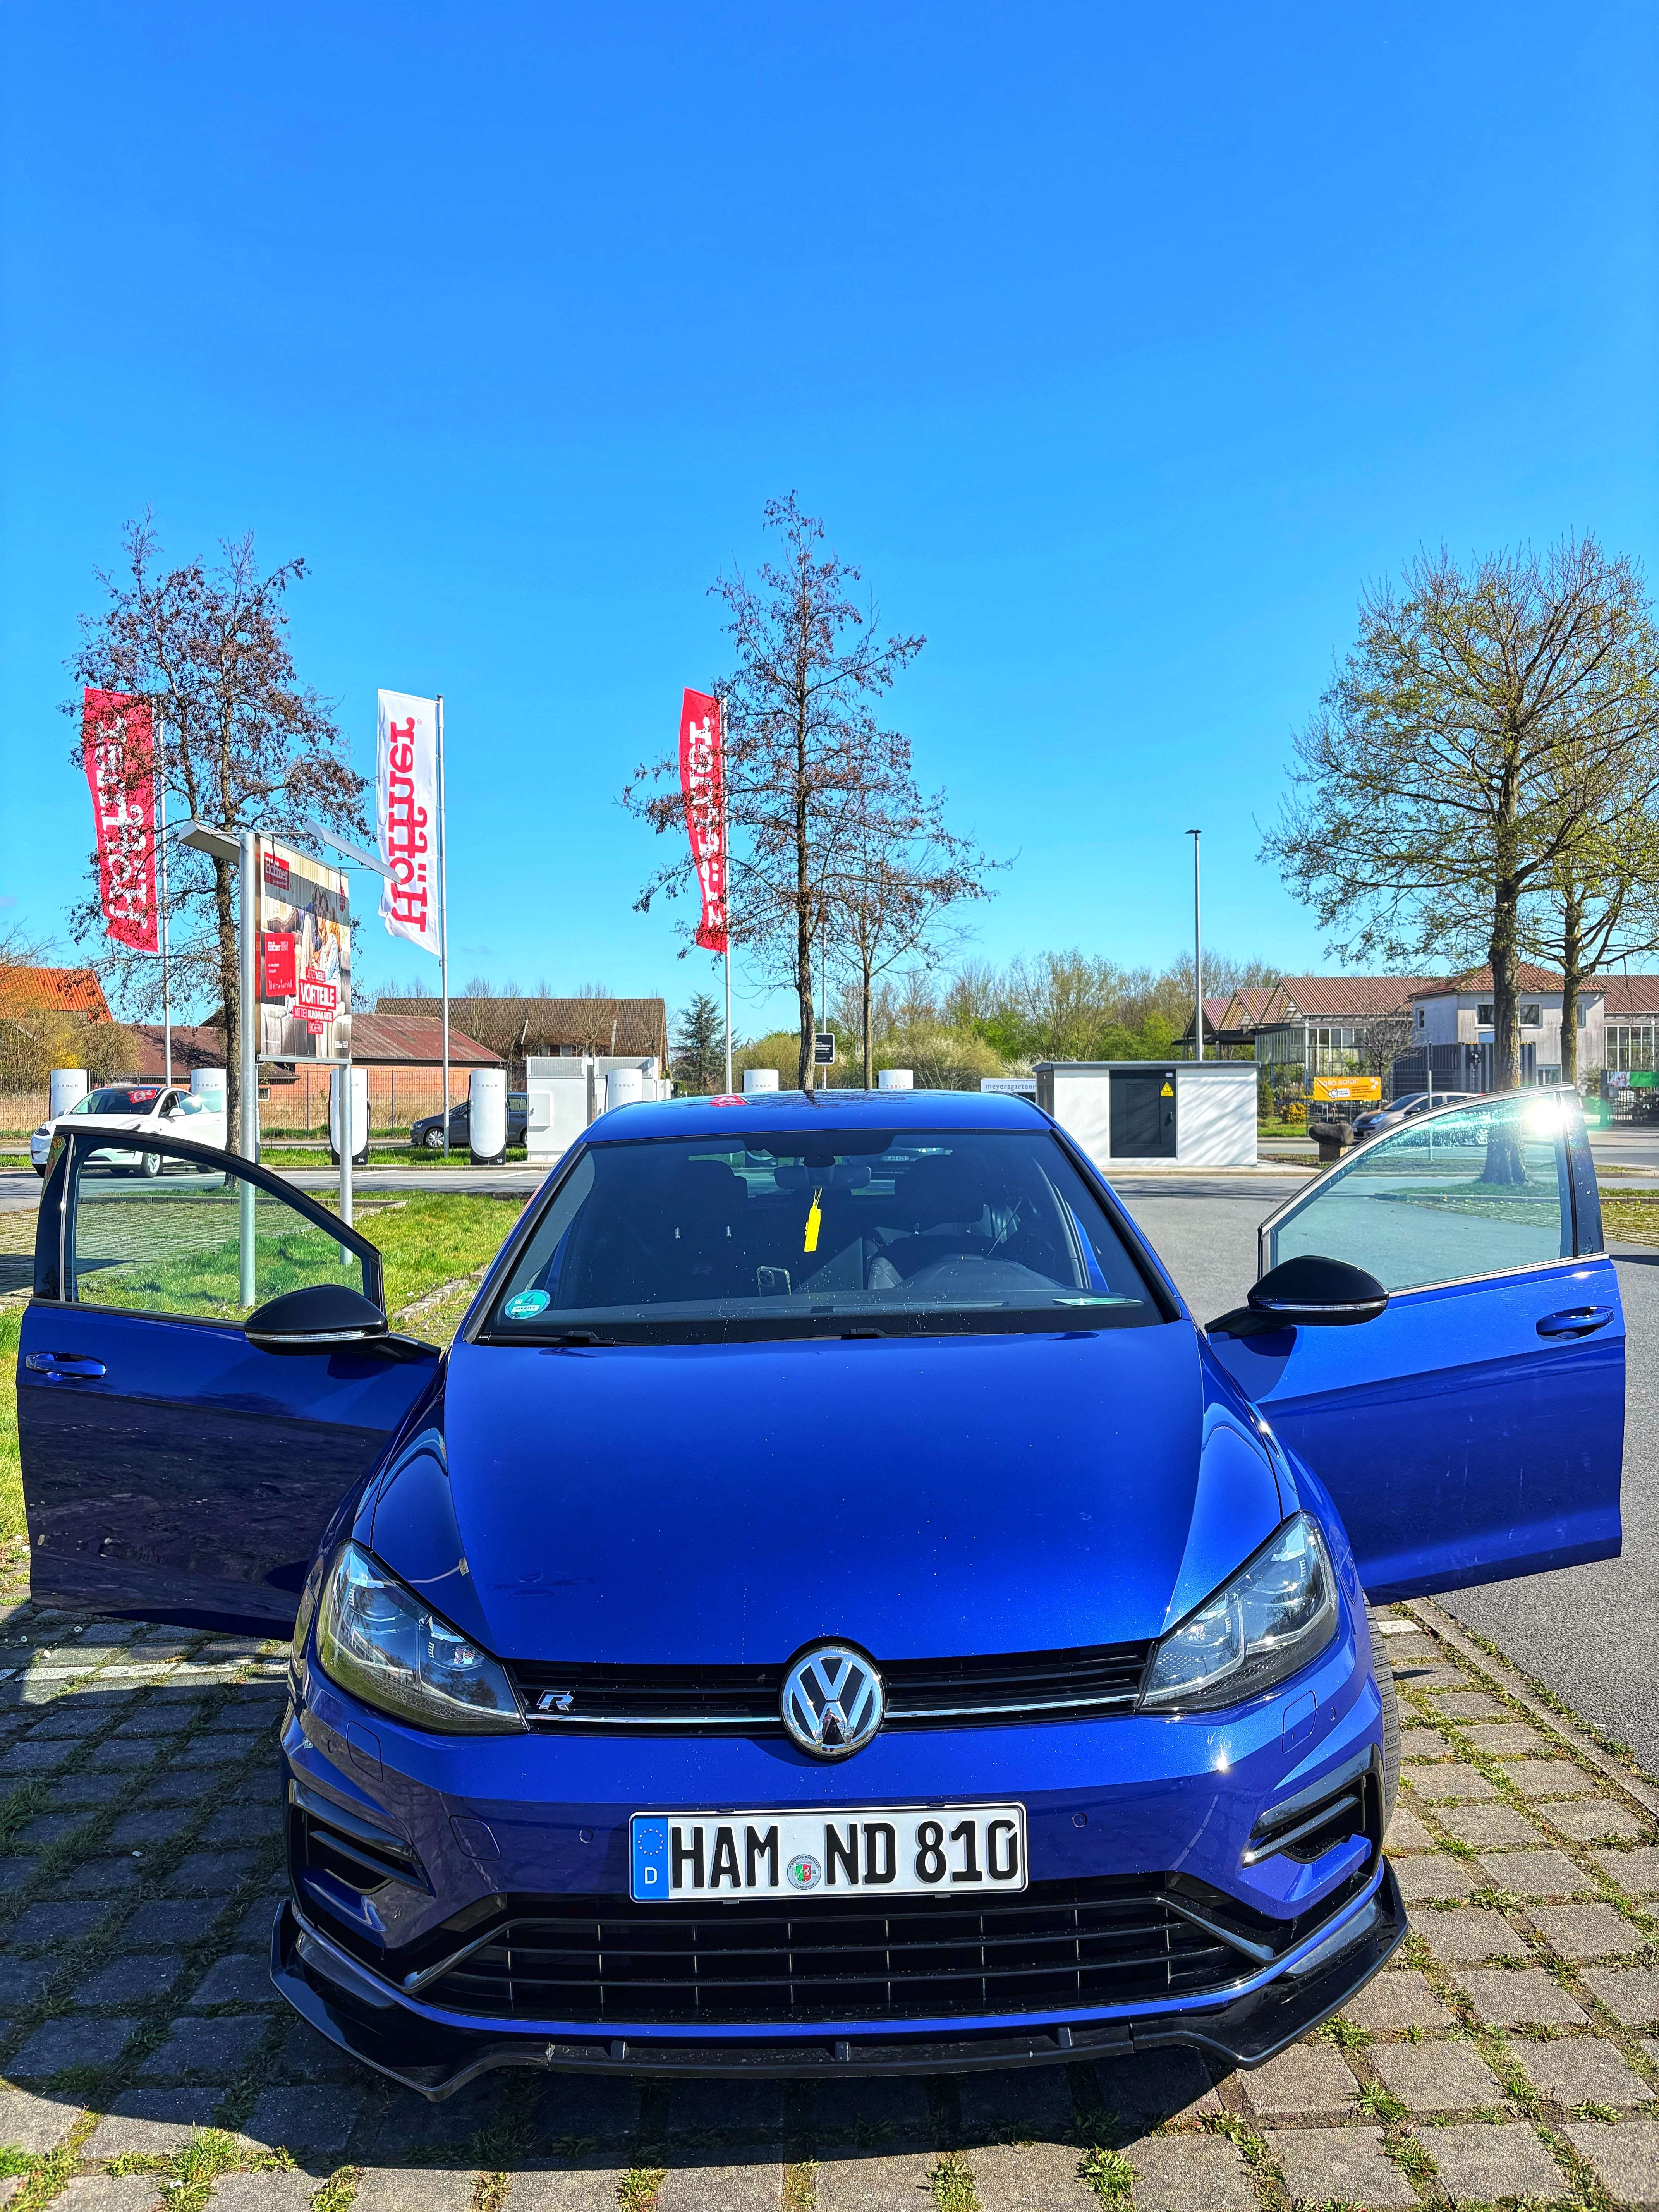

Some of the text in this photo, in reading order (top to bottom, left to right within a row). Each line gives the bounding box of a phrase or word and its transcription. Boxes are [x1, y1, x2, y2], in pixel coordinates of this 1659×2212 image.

[300, 982, 335, 1007] VORTEILE
[523, 1293, 535, 1304] 4
[537, 1690, 575, 1711] R
[672, 1819, 1018, 1890] HAM ND 810
[644, 1867, 659, 1885] D
